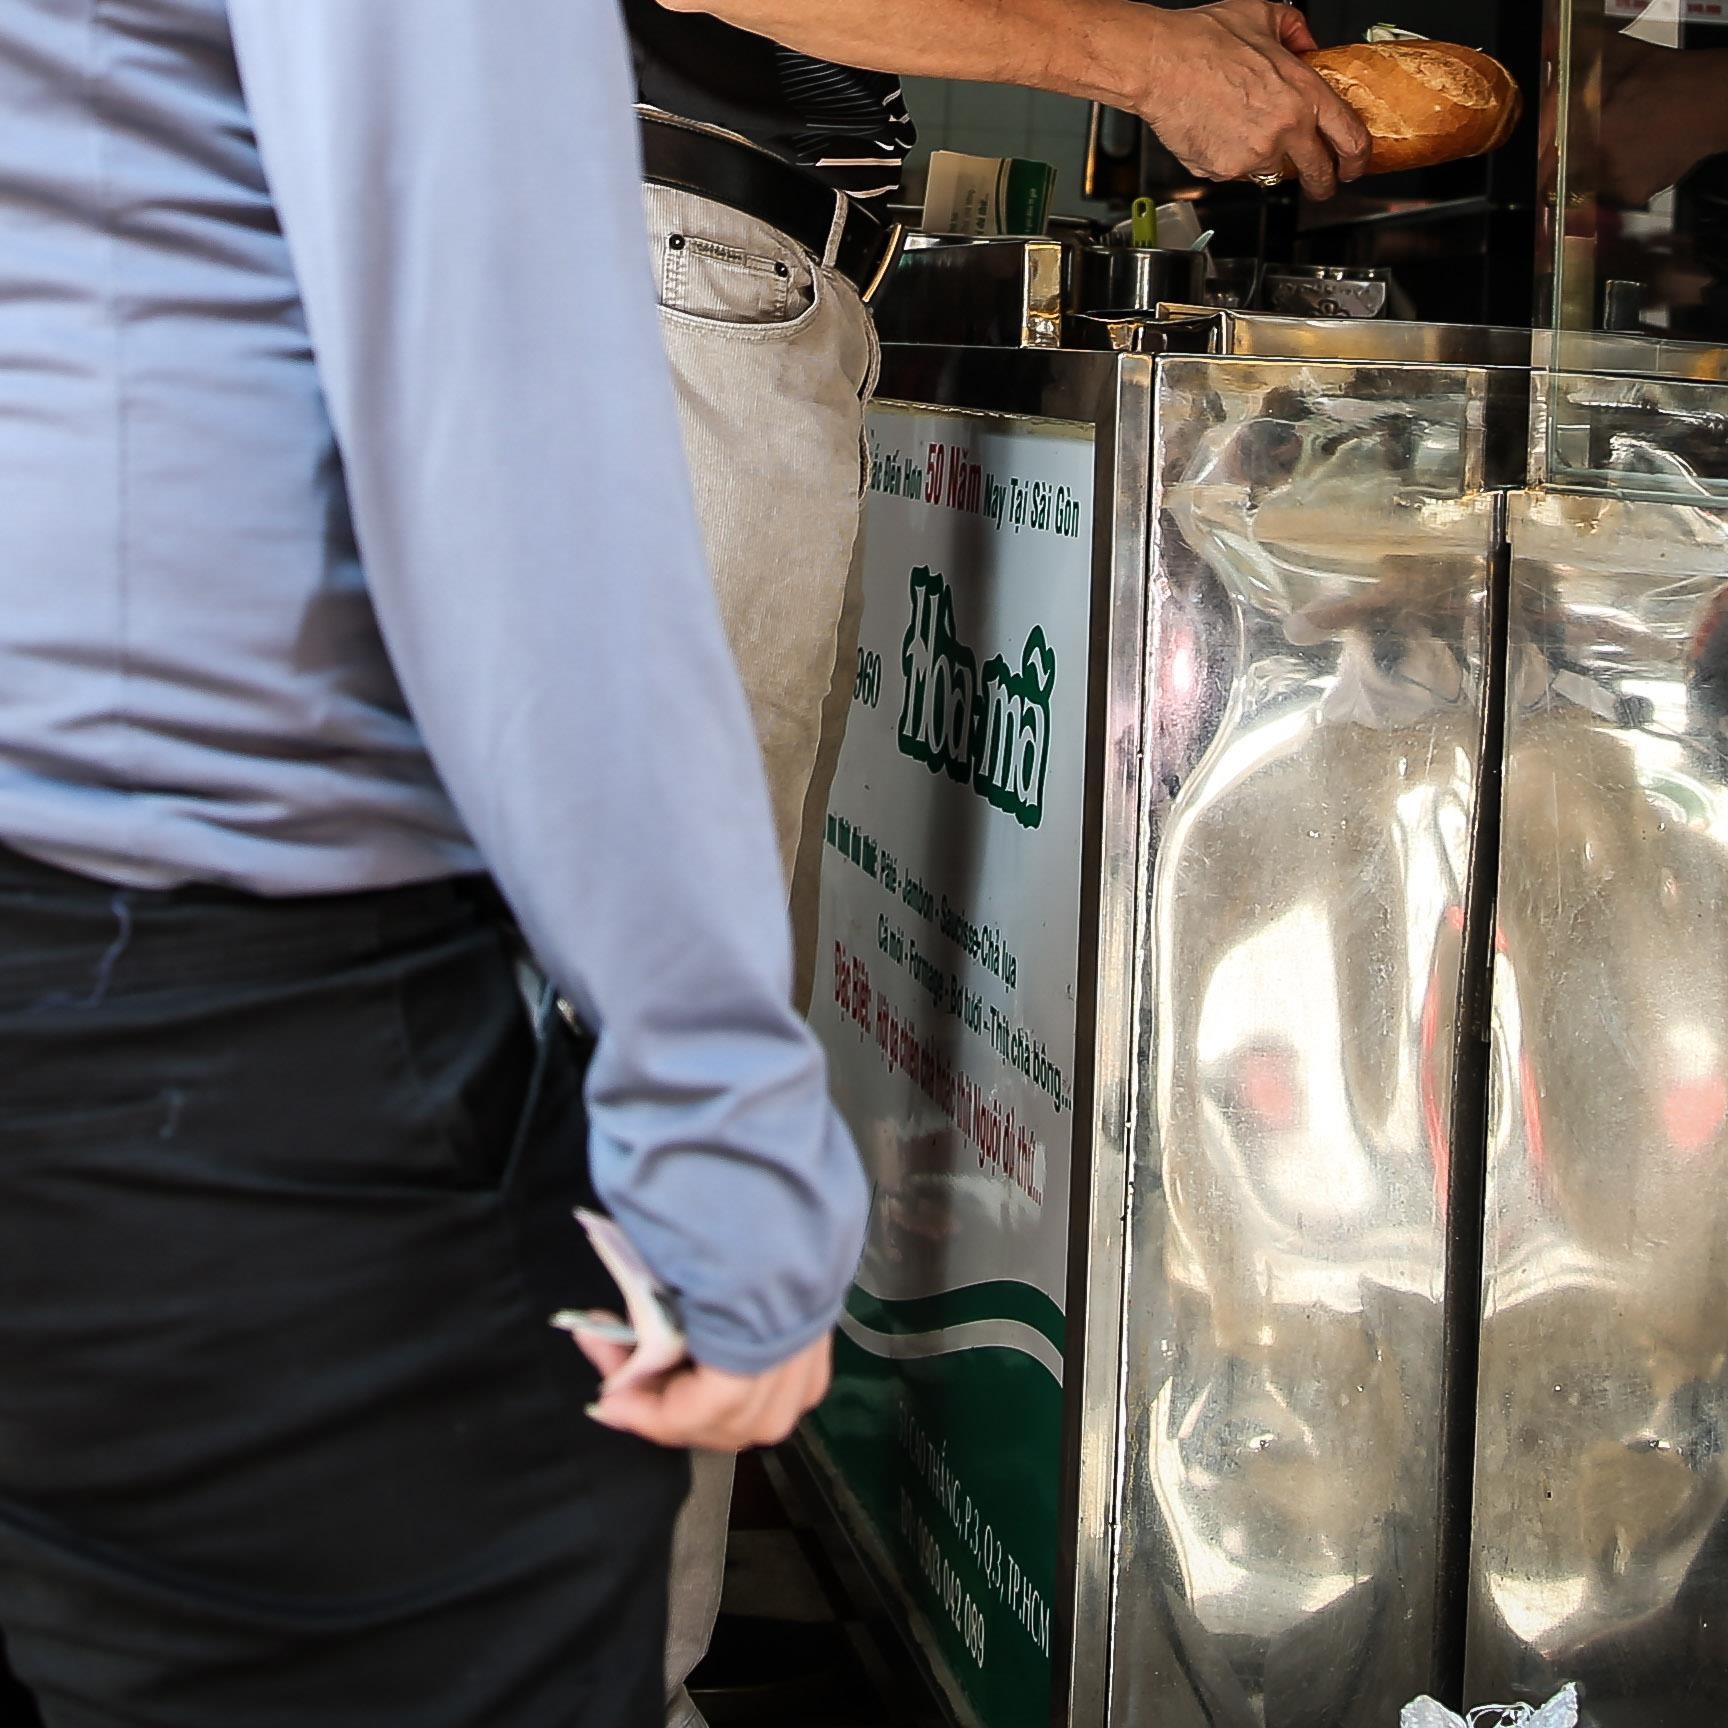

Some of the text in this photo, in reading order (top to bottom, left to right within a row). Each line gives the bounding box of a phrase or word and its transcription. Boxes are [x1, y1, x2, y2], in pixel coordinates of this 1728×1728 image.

[924, 443, 945, 506] 50
[946, 445, 982, 514] Năm
[983, 472, 1007, 531] Nay
[1008, 477, 1029, 534] Tại
[1030, 480, 1053, 532] Sài
[1053, 485, 1080, 538] Gòn
[964, 1593, 984, 1669] 089
[1008, 1554, 1050, 1658] TP.HCM
